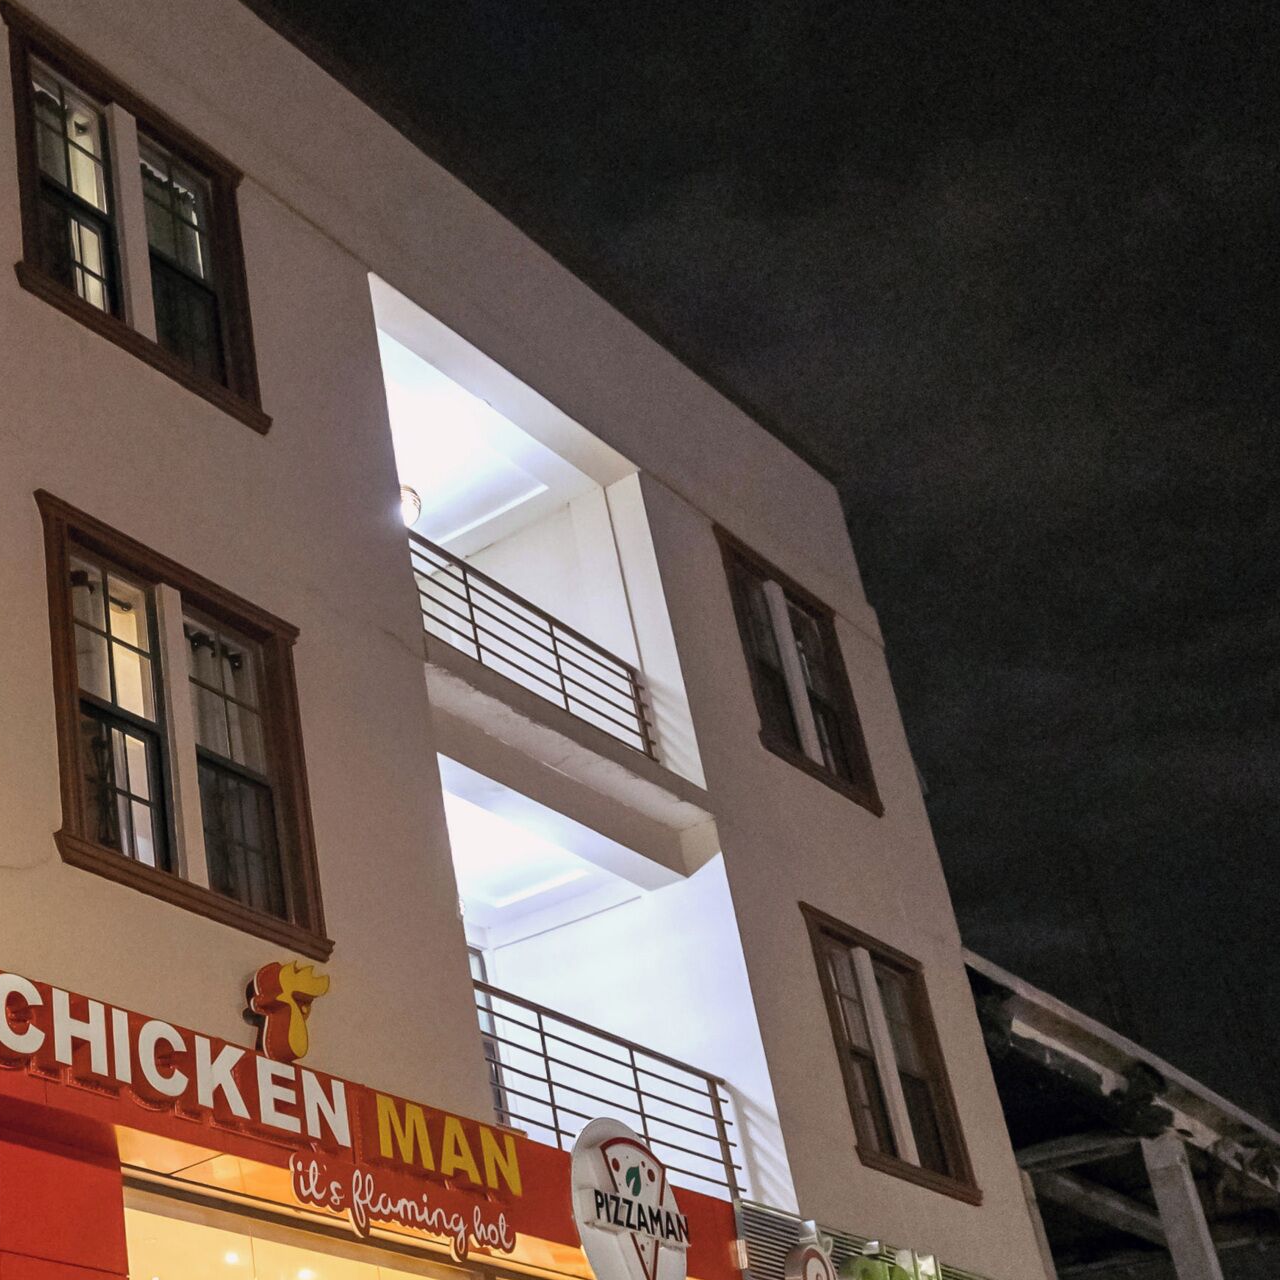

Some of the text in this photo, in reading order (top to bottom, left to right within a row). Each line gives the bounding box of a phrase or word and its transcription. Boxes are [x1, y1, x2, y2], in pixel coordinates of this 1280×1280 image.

[377, 1094, 522, 1197] MAN
[297, 1160, 515, 1254] it's flaming hot
[594, 1189, 691, 1244] PIZZAMAN
